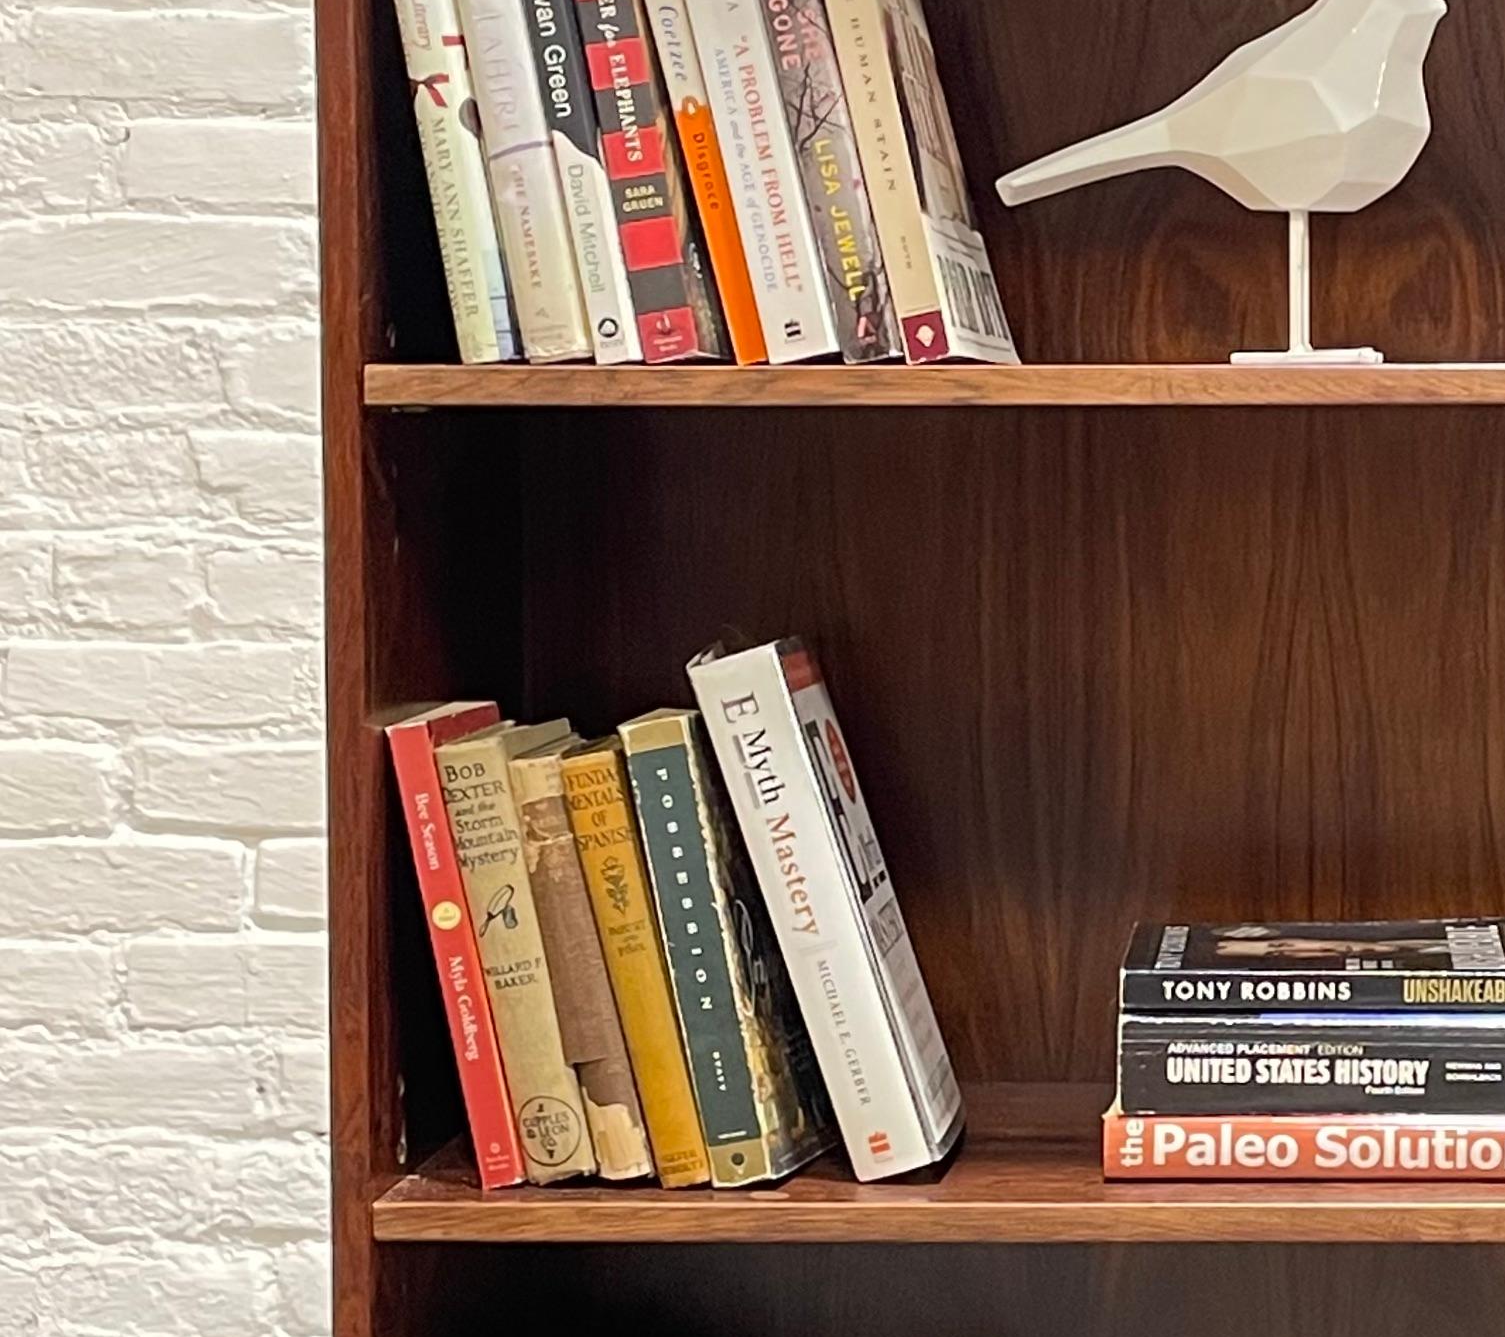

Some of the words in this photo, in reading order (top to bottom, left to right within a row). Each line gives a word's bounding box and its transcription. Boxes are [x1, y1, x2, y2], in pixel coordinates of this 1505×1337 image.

[597, 23, 620, 48] for
[659, 5, 687, 81] Coetzee
[543, 44, 572, 118] Green
[850, 17, 877, 103] HUMAN
[874, 119, 896, 191] STAIN
[608, 54, 643, 162] ELEPHANTS
[431, 117, 454, 173] MARY
[692, 132, 719, 210] Disgrace
[714, 47, 737, 116] AMERICA
[740, 163, 756, 193] AGE
[749, 211, 778, 292] GENOCIDE
[738, 64, 774, 161] PROBLEM
[761, 168, 787, 227] FROM
[441, 179, 461, 223] ANN
[622, 196, 664, 212] GRUEN
[624, 184, 656, 199] SARA
[520, 205, 542, 288] NAMESAKE
[567, 164, 591, 217] David
[581, 222, 606, 294] Mitchell
[815, 139, 840, 195] LISA
[831, 206, 866, 301] JEWELL
[452, 229, 479, 318] SHAFFER
[444, 762, 486, 783] BOB
[415, 793, 430, 820] Bee
[455, 803, 475, 816] and
[477, 801, 496, 814] the
[455, 815, 505, 834] Storm
[591, 810, 607, 828] OF
[721, 691, 760, 724] E
[743, 727, 786, 806] Myth
[766, 812, 820, 937] Mastery
[421, 823, 440, 870] Season
[655, 767, 713, 1010] POSSESSION
[449, 955, 466, 992] Myla
[494, 973, 538, 991] BAKER
[1162, 980, 1231, 1001] TONY
[1240, 981, 1352, 1001] ROBBINS
[457, 994, 479, 1062] Goldberg
[817, 959, 846, 1026] MICHAEL
[839, 1030, 850, 1045] E.
[845, 1047, 871, 1106] GERBER
[1167, 1043, 1235, 1055] ADVANCED
[1236, 1043, 1311, 1055] PLACEMENT
[1317, 1044, 1364, 1055] EDITION
[1166, 1057, 1252, 1084] UNITED
[1255, 1058, 1331, 1085] STATES
[1334, 1059, 1430, 1085] HISTORY
[1120, 1118, 1145, 1167] the
[1153, 1123, 1299, 1168] Paleo
